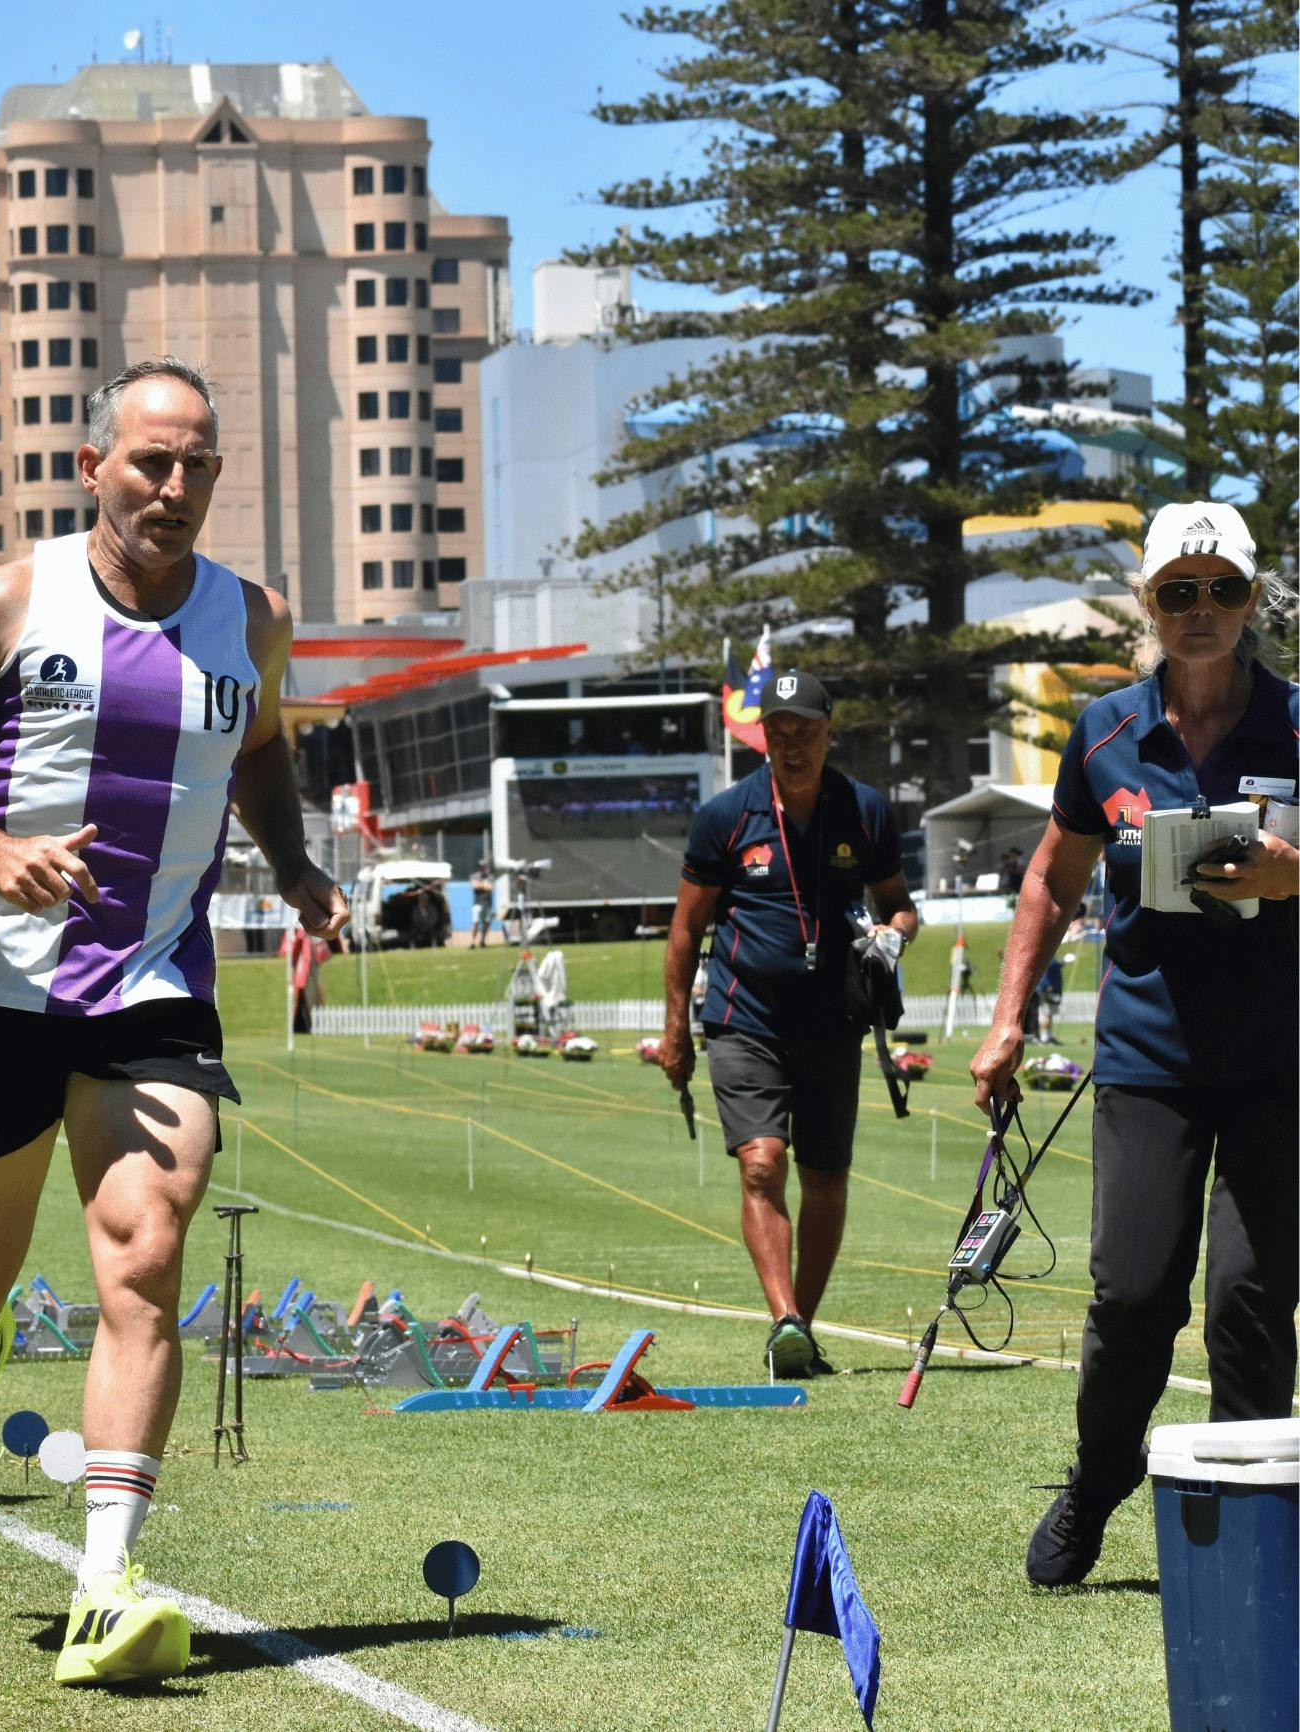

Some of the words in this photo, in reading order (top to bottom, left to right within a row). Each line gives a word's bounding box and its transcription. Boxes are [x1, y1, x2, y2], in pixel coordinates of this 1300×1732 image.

[1182, 528, 1222, 537] adidas
[34, 687, 65, 698] ATHLETIC
[66, 688, 94, 700] LEAGUE
[200, 670, 240, 733] 19
[1117, 829, 1142, 840] UTH
